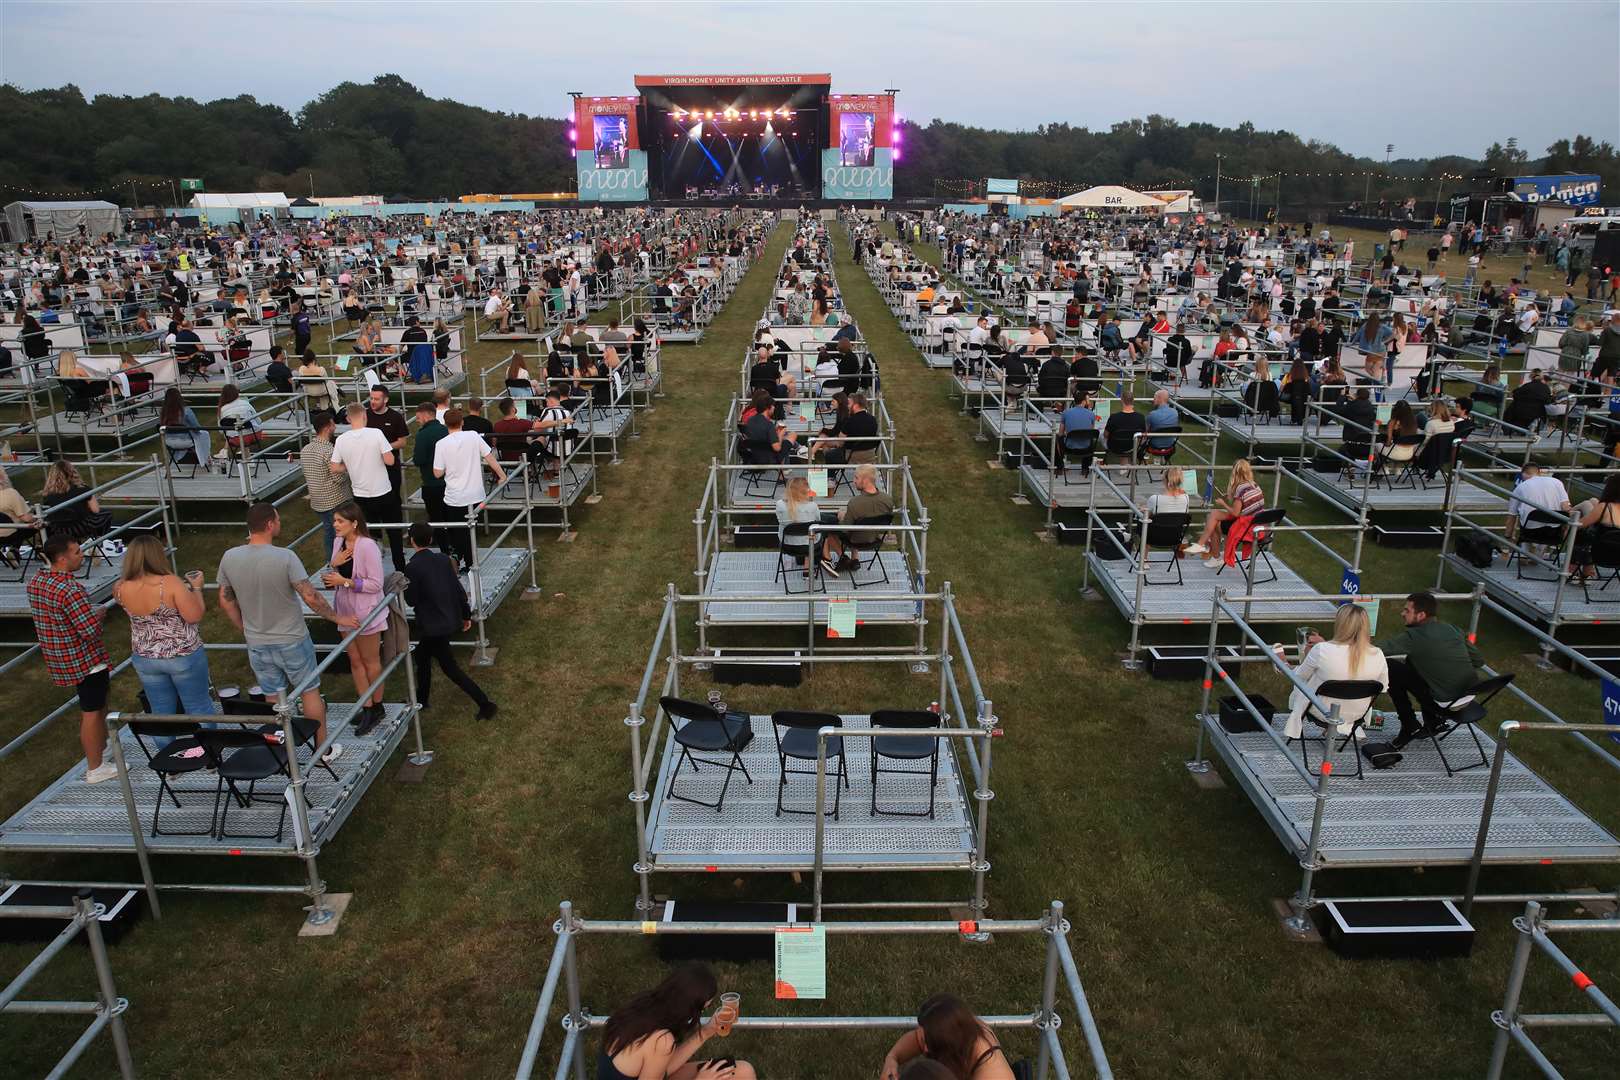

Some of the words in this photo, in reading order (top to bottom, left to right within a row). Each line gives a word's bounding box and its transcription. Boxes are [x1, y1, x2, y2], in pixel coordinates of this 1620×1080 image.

[761, 76, 802, 84] NEWCASTLE
[1105, 196, 1122, 204] BAR
[1343, 578, 1358, 595] 462
[1604, 696, 1620, 715] 47
